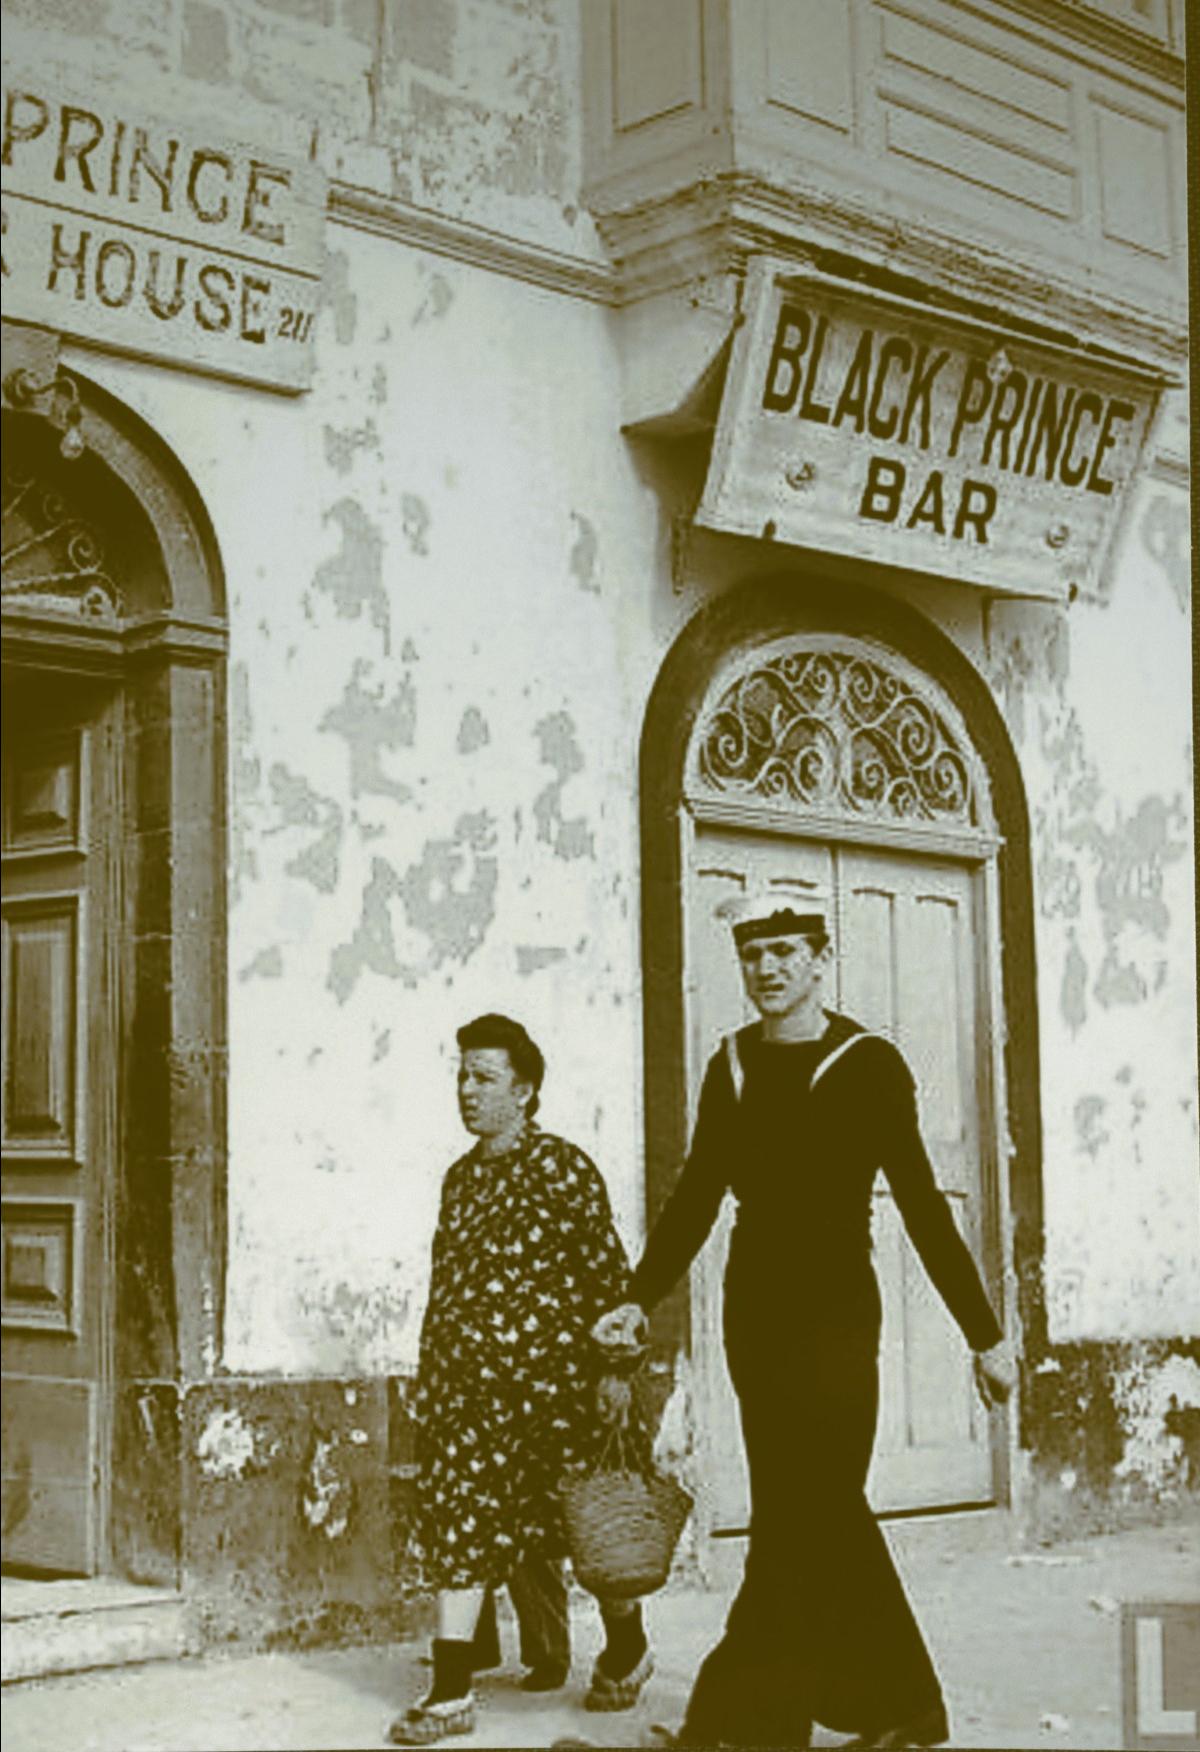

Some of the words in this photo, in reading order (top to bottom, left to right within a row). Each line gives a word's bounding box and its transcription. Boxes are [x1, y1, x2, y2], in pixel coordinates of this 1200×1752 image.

[2, 89, 291, 246] PRINCE
[47, 223, 271, 344] HOUSE
[762, 303, 950, 450] BLACK
[947, 355, 1135, 495] PRINCE
[859, 455, 998, 545] BAR
